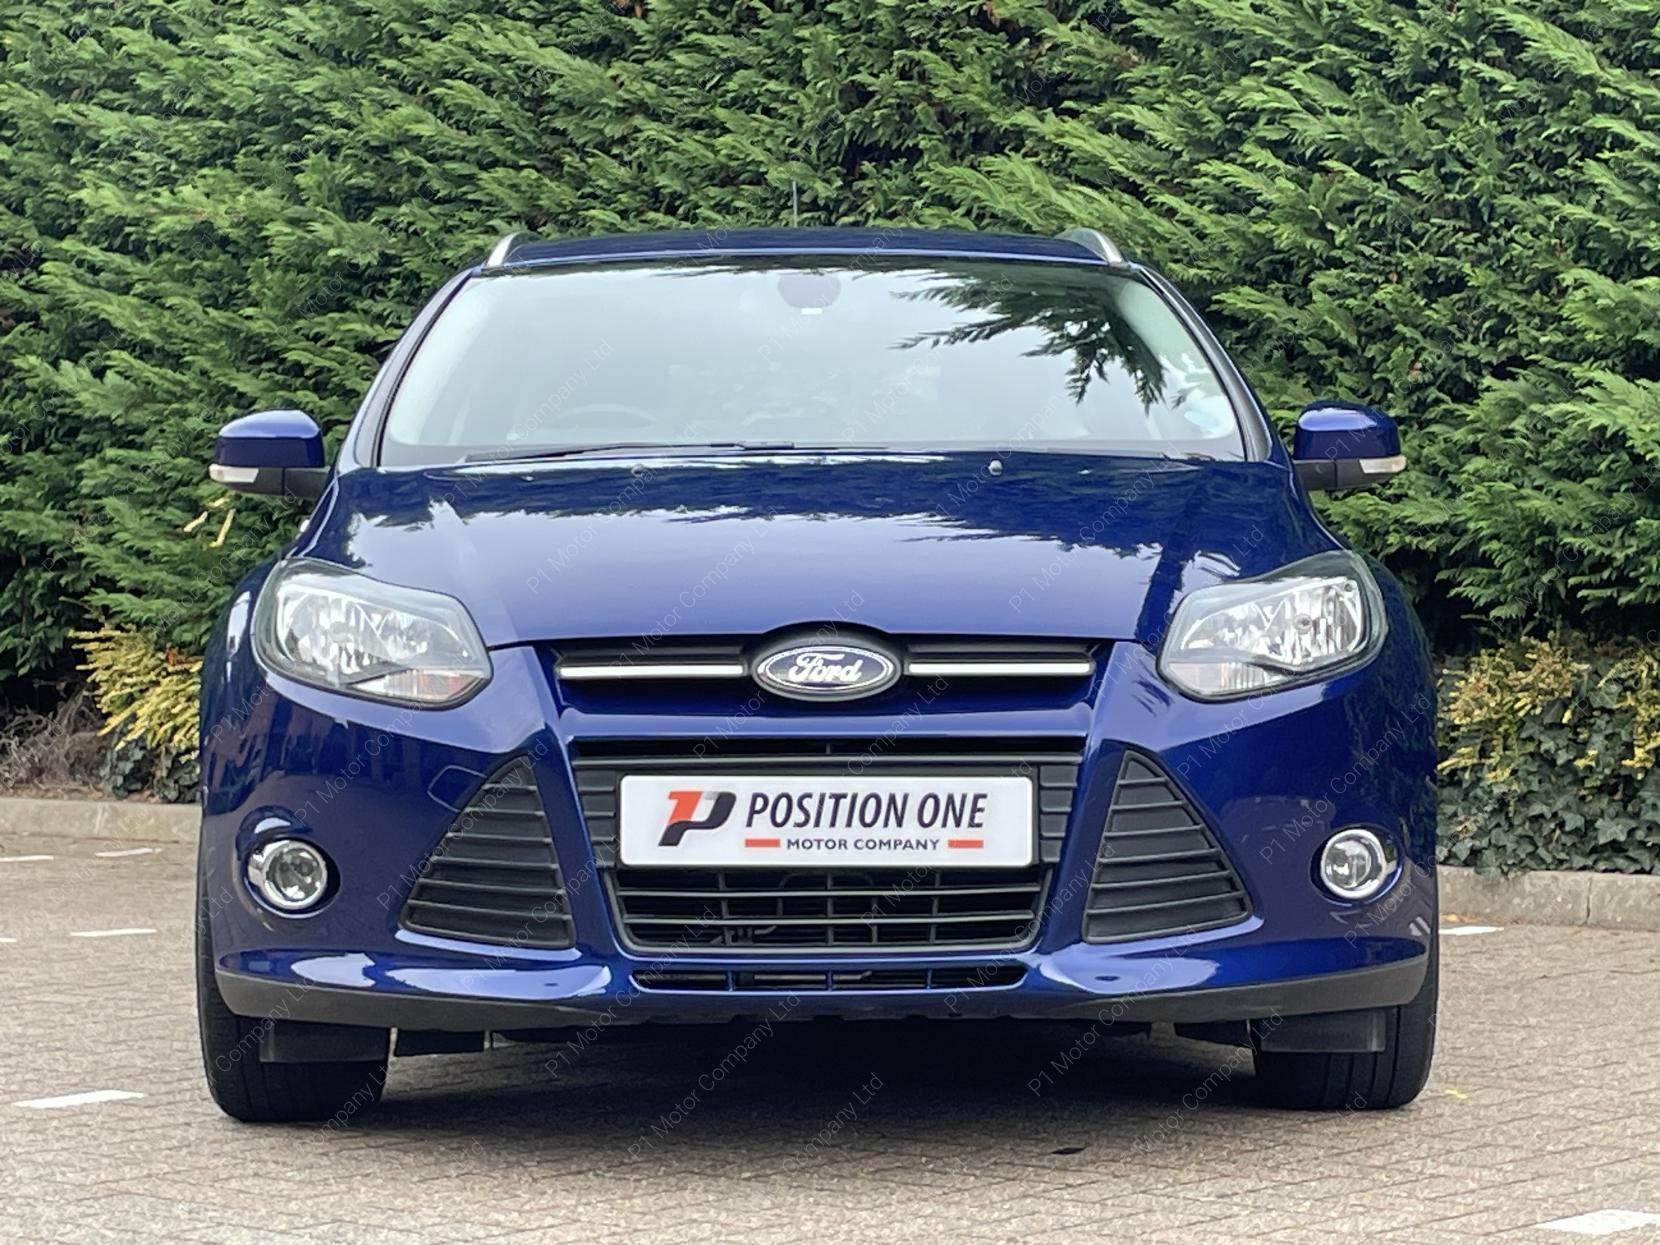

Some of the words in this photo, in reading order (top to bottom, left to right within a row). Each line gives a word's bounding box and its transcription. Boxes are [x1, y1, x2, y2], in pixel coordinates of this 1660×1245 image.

[788, 652, 863, 683] Ford
[745, 792, 909, 828] POSITION
[917, 792, 988, 828] ONE
[786, 838, 848, 851] MOTOR
[853, 838, 940, 851] COMPANY
